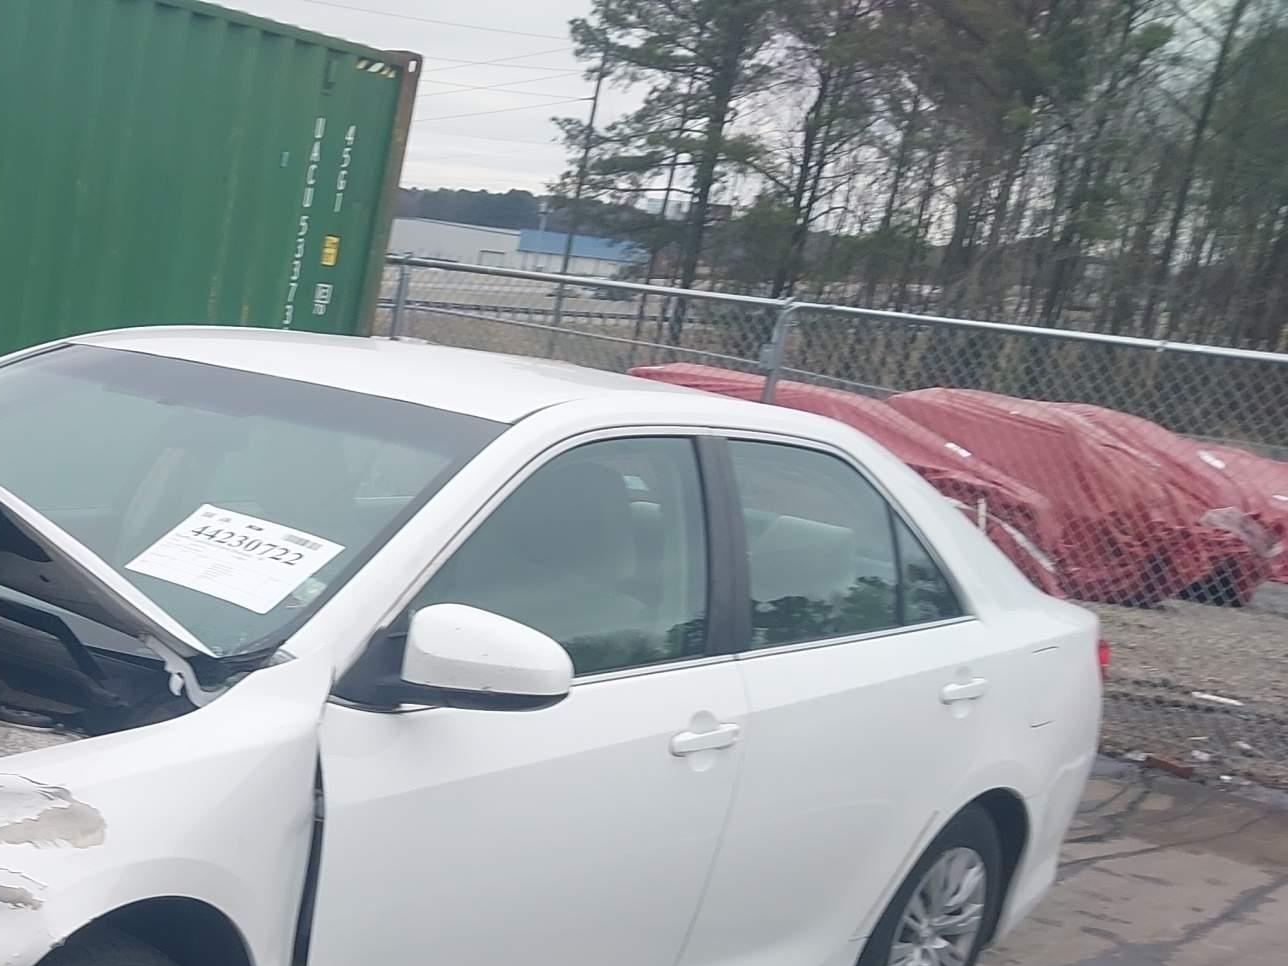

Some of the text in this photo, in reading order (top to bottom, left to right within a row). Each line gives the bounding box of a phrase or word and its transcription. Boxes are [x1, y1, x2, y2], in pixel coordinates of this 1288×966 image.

[281, 117, 326, 330] UACU 53373
[189, 525, 305, 566] 44230722
